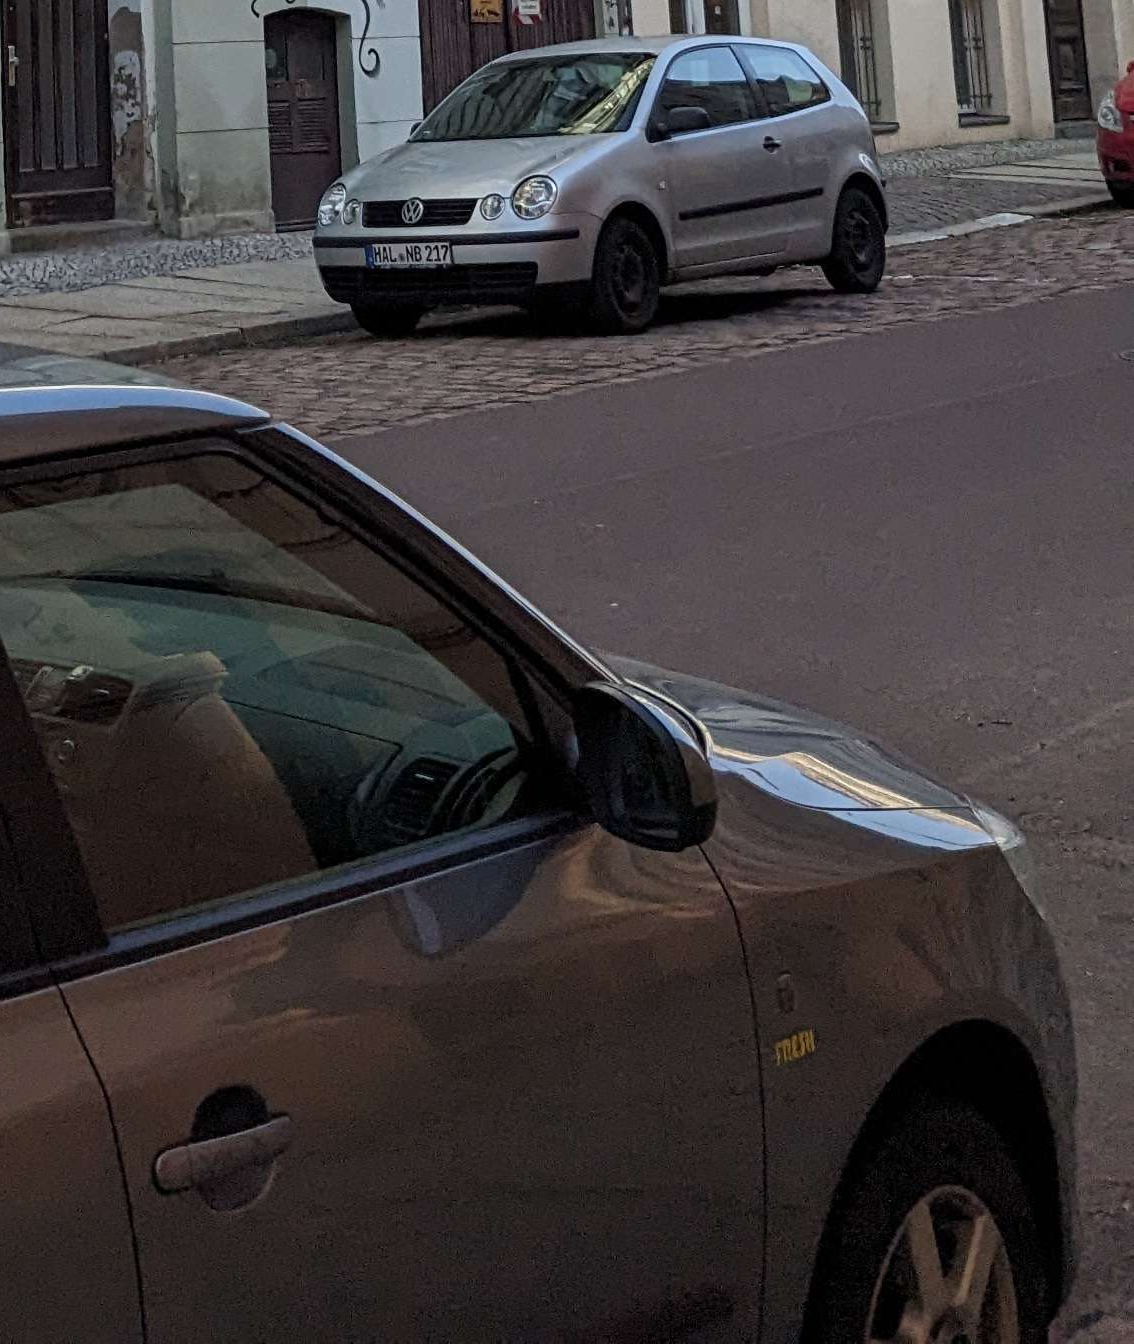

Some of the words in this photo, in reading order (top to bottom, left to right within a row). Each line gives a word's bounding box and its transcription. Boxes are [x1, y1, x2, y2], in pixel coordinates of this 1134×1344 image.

[373, 246, 397, 263] HAL
[406, 245, 422, 262] NB
[425, 244, 449, 262] 217
[776, 1029, 815, 1066] FRESH
